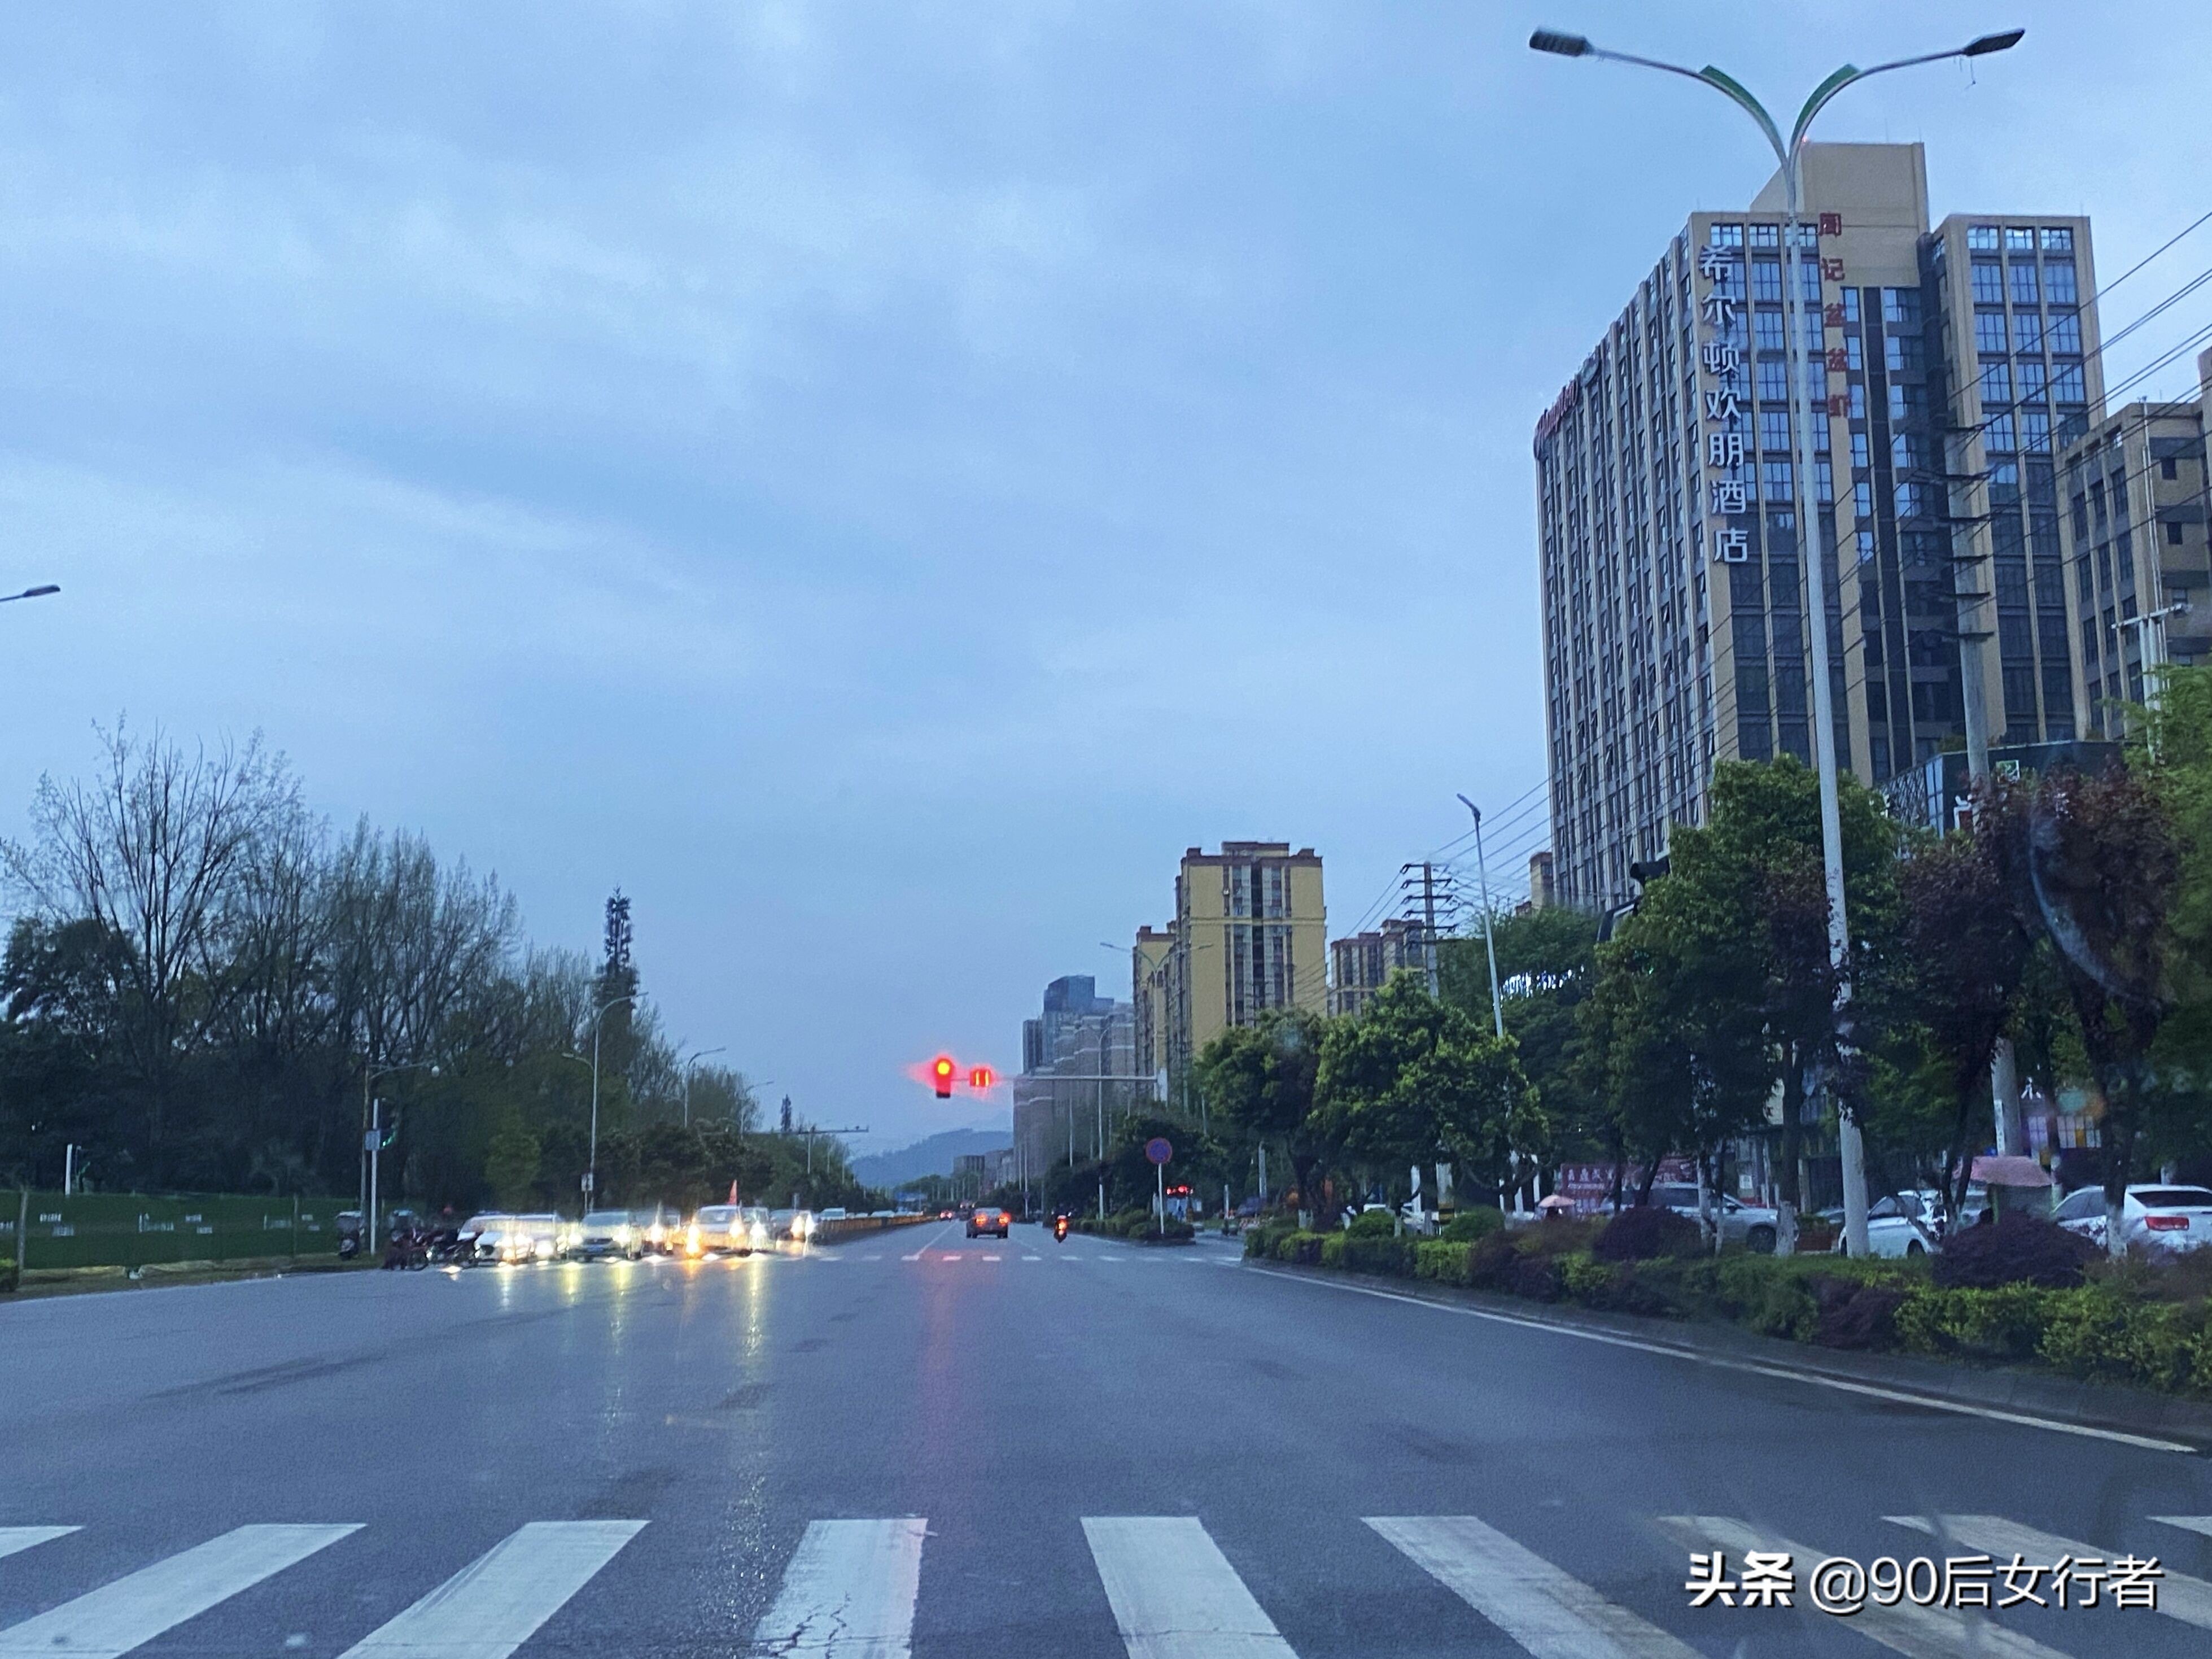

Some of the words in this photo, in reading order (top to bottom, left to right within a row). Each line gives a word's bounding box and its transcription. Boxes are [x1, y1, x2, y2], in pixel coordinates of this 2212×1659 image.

[1699, 244, 1750, 563] 希尔顿欢朋酒店
